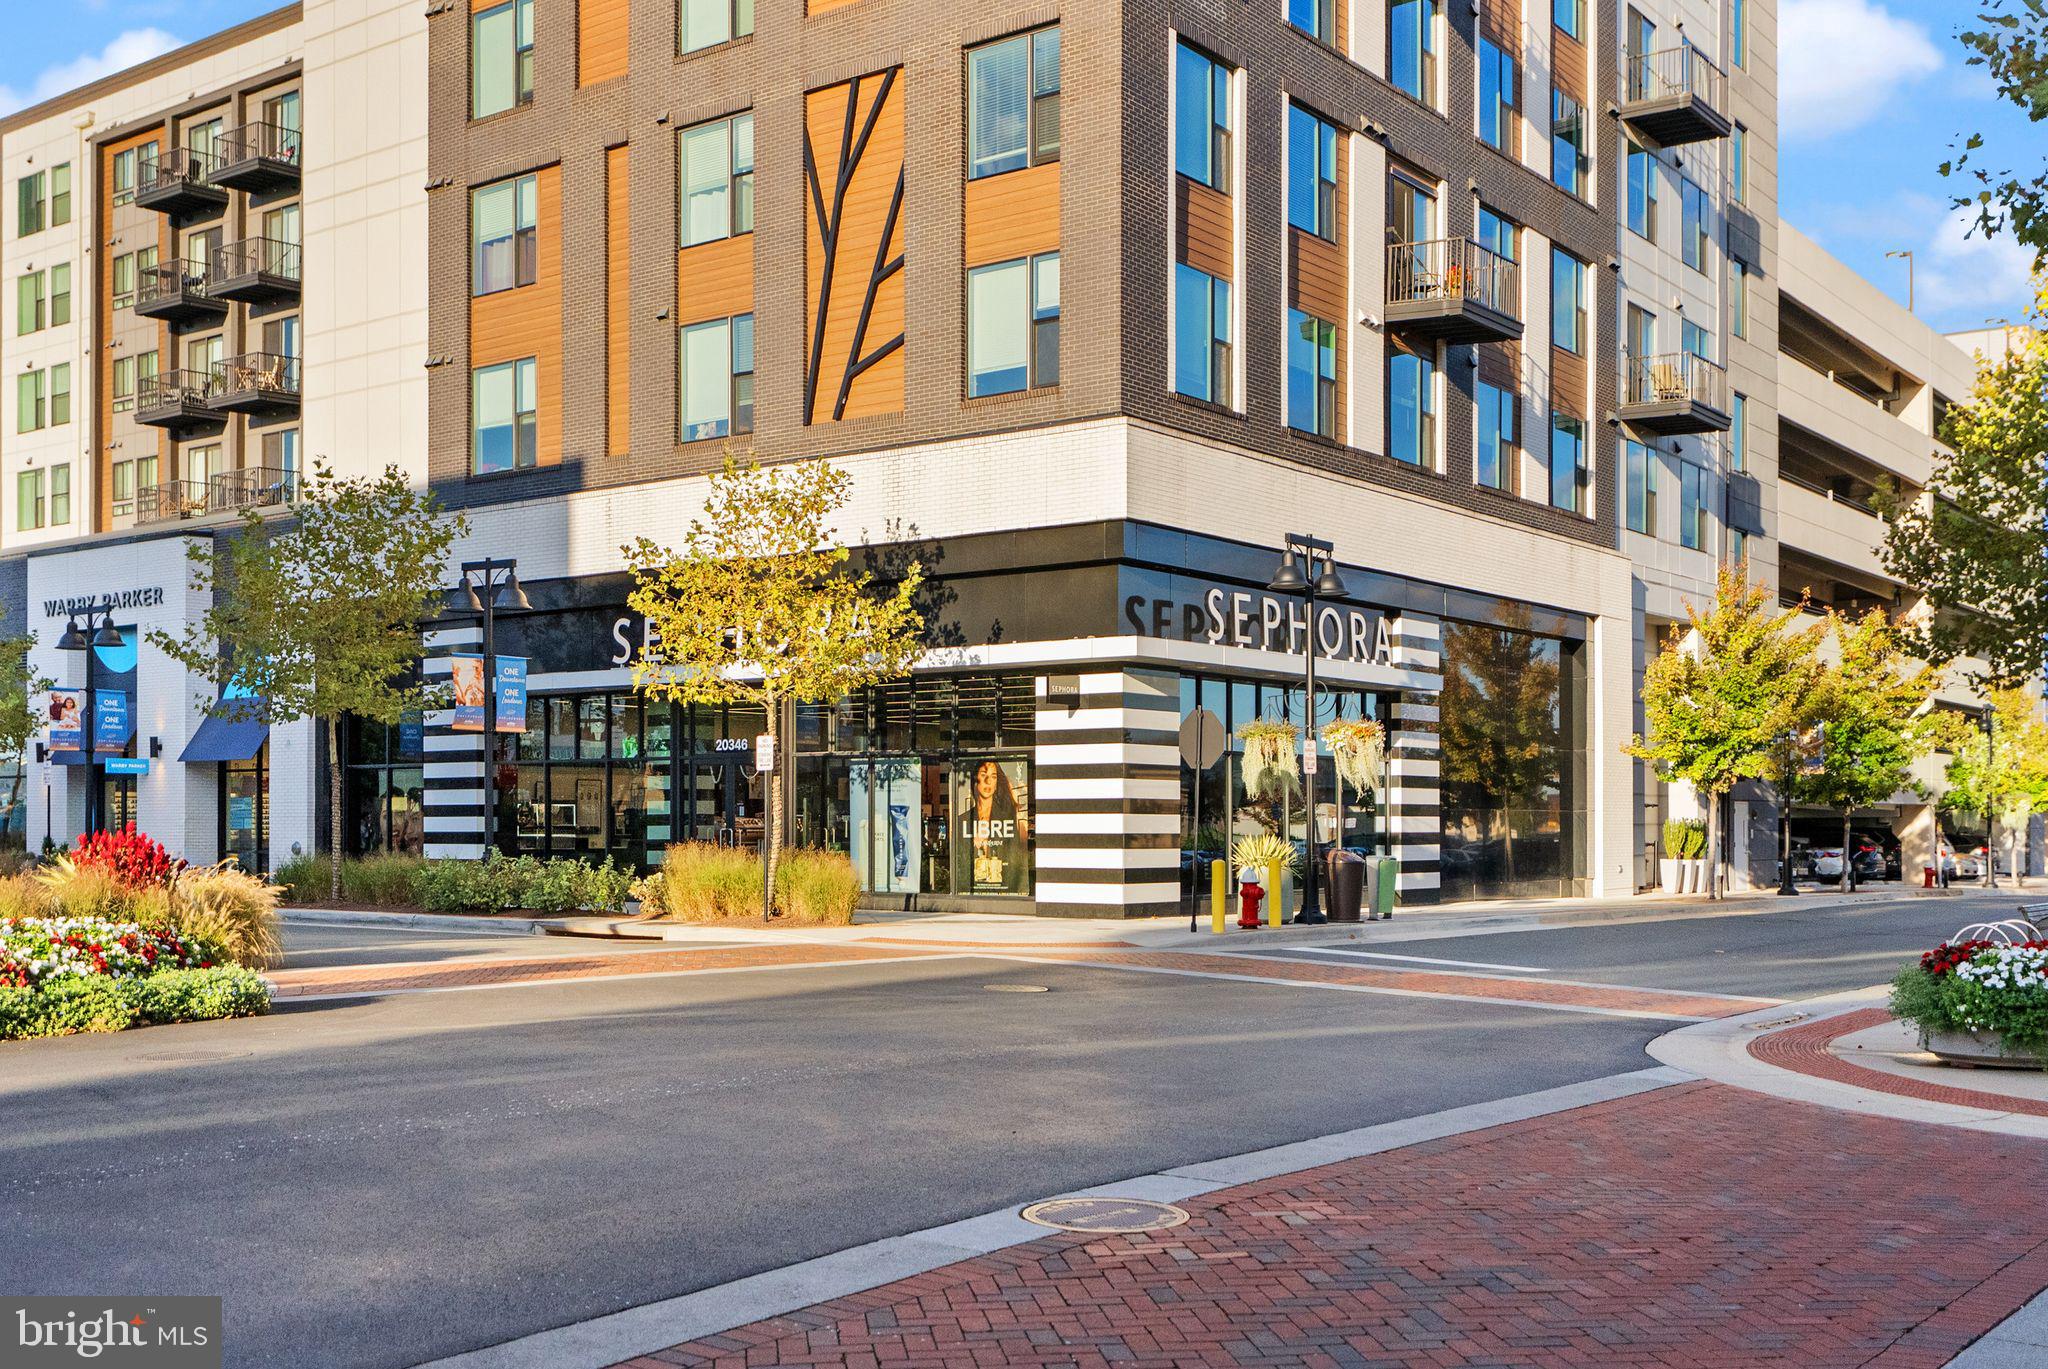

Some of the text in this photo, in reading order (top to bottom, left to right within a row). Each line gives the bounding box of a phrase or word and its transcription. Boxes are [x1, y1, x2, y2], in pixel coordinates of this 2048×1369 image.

[44, 587, 163, 617] WARBY PARKER
[1206, 588, 1393, 662] SEPHORA
[504, 668, 519, 676] ONE
[504, 689, 519, 697] ONE
[1051, 685, 1078, 693] SEPHORA
[715, 739, 748, 751] 20346
[962, 819, 1015, 838] LIBRE
